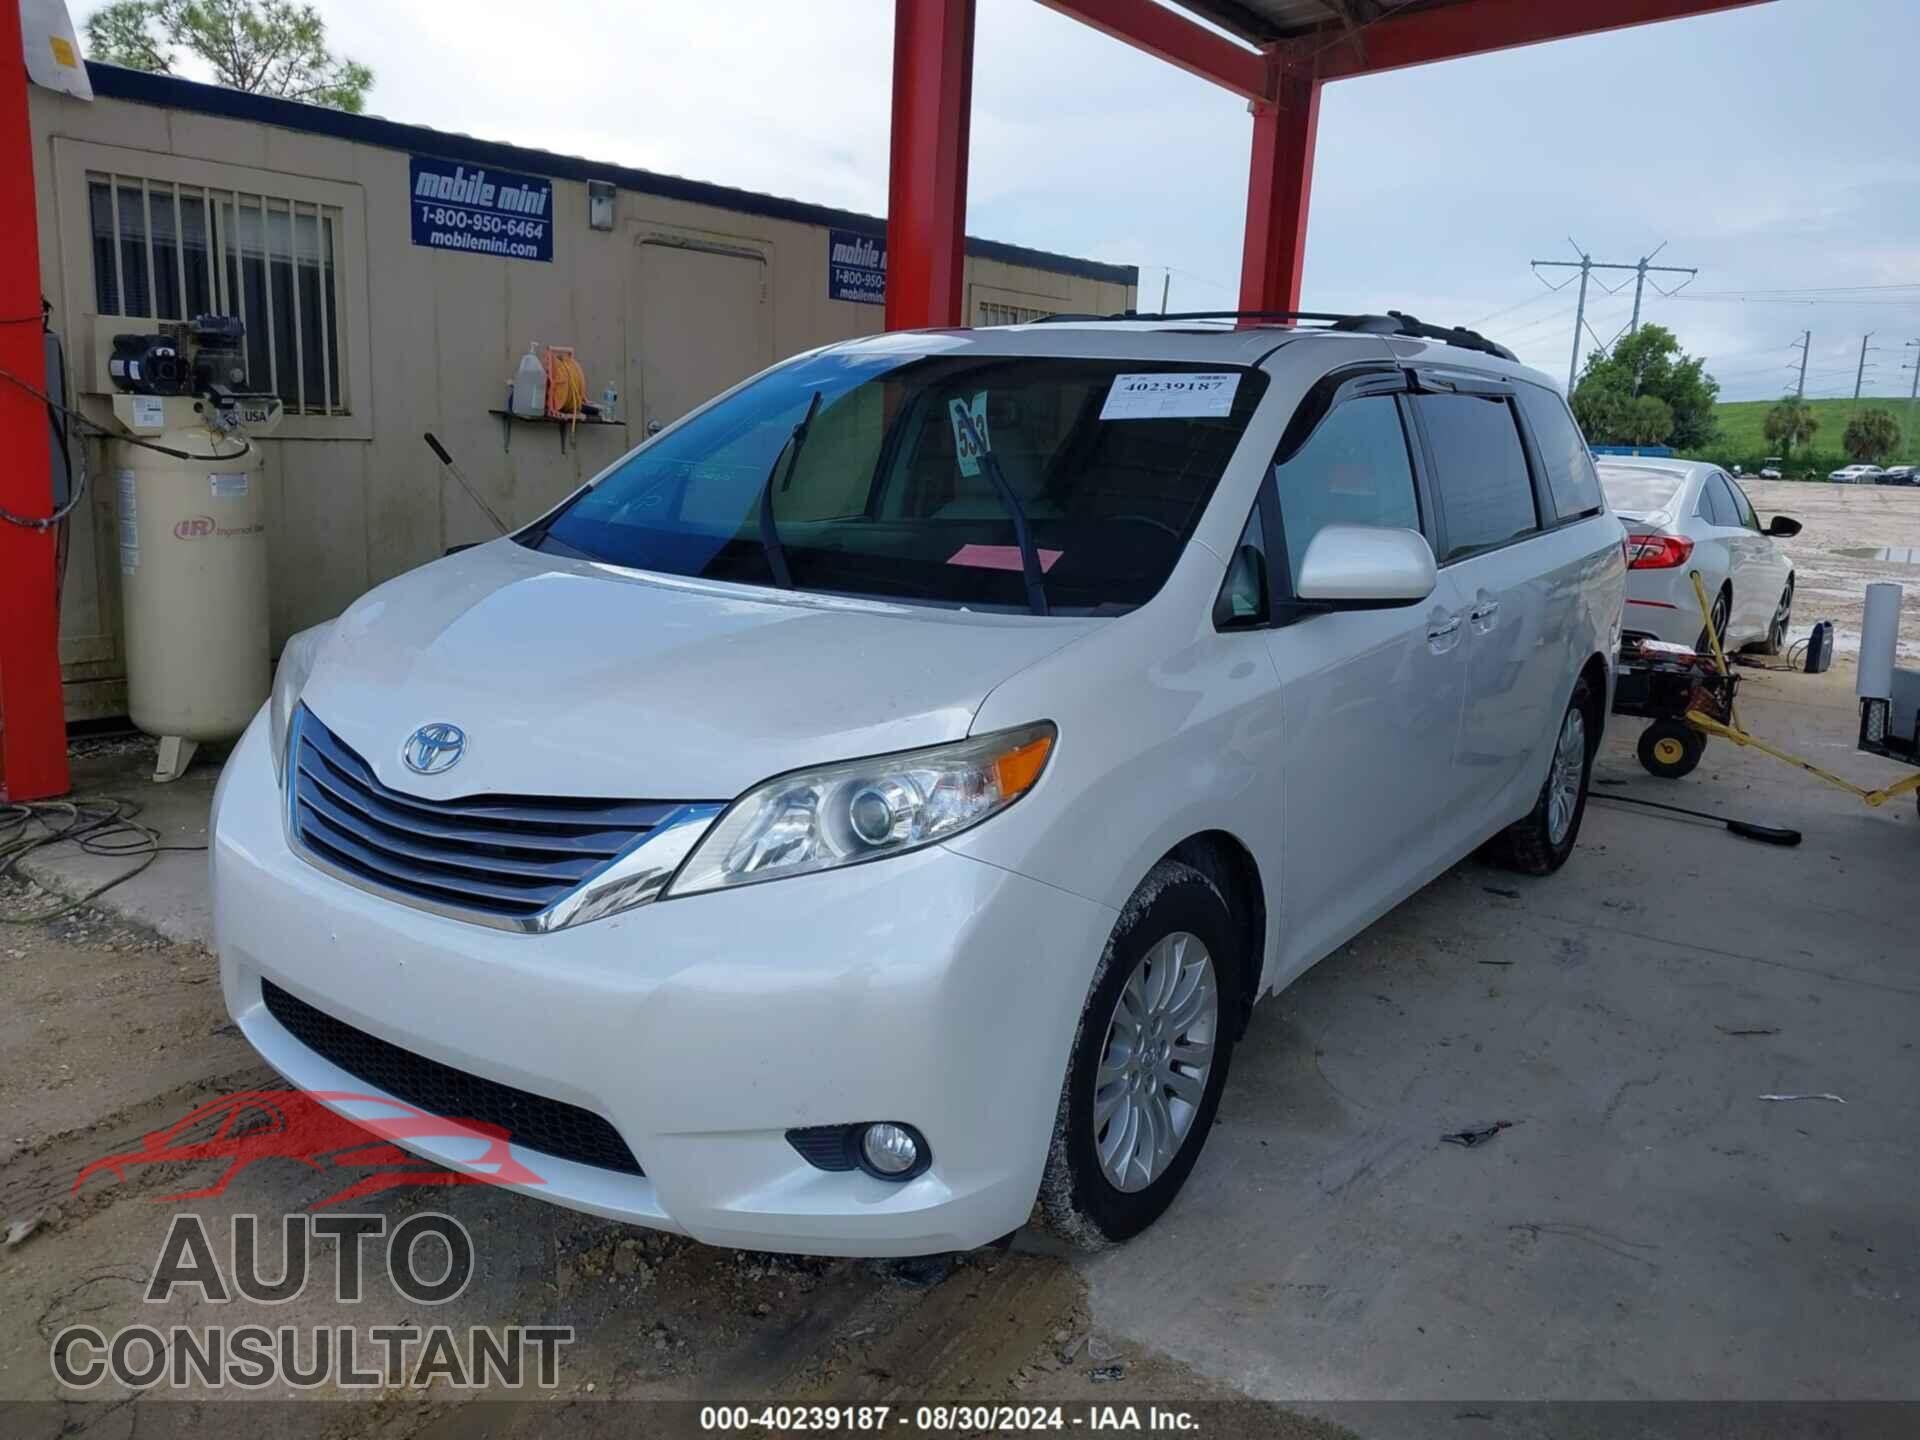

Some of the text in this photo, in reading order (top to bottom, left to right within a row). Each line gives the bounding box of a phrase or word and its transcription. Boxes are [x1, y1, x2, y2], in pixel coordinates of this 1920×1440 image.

[415, 166, 548, 215] mobile mini
[422, 206, 543, 239] 1-800-950-6464
[430, 231, 538, 257] mobilemini.com
[832, 238, 880, 268] mobile
[1124, 382, 1222, 392] 40239187
[245, 410, 267, 422] USA
